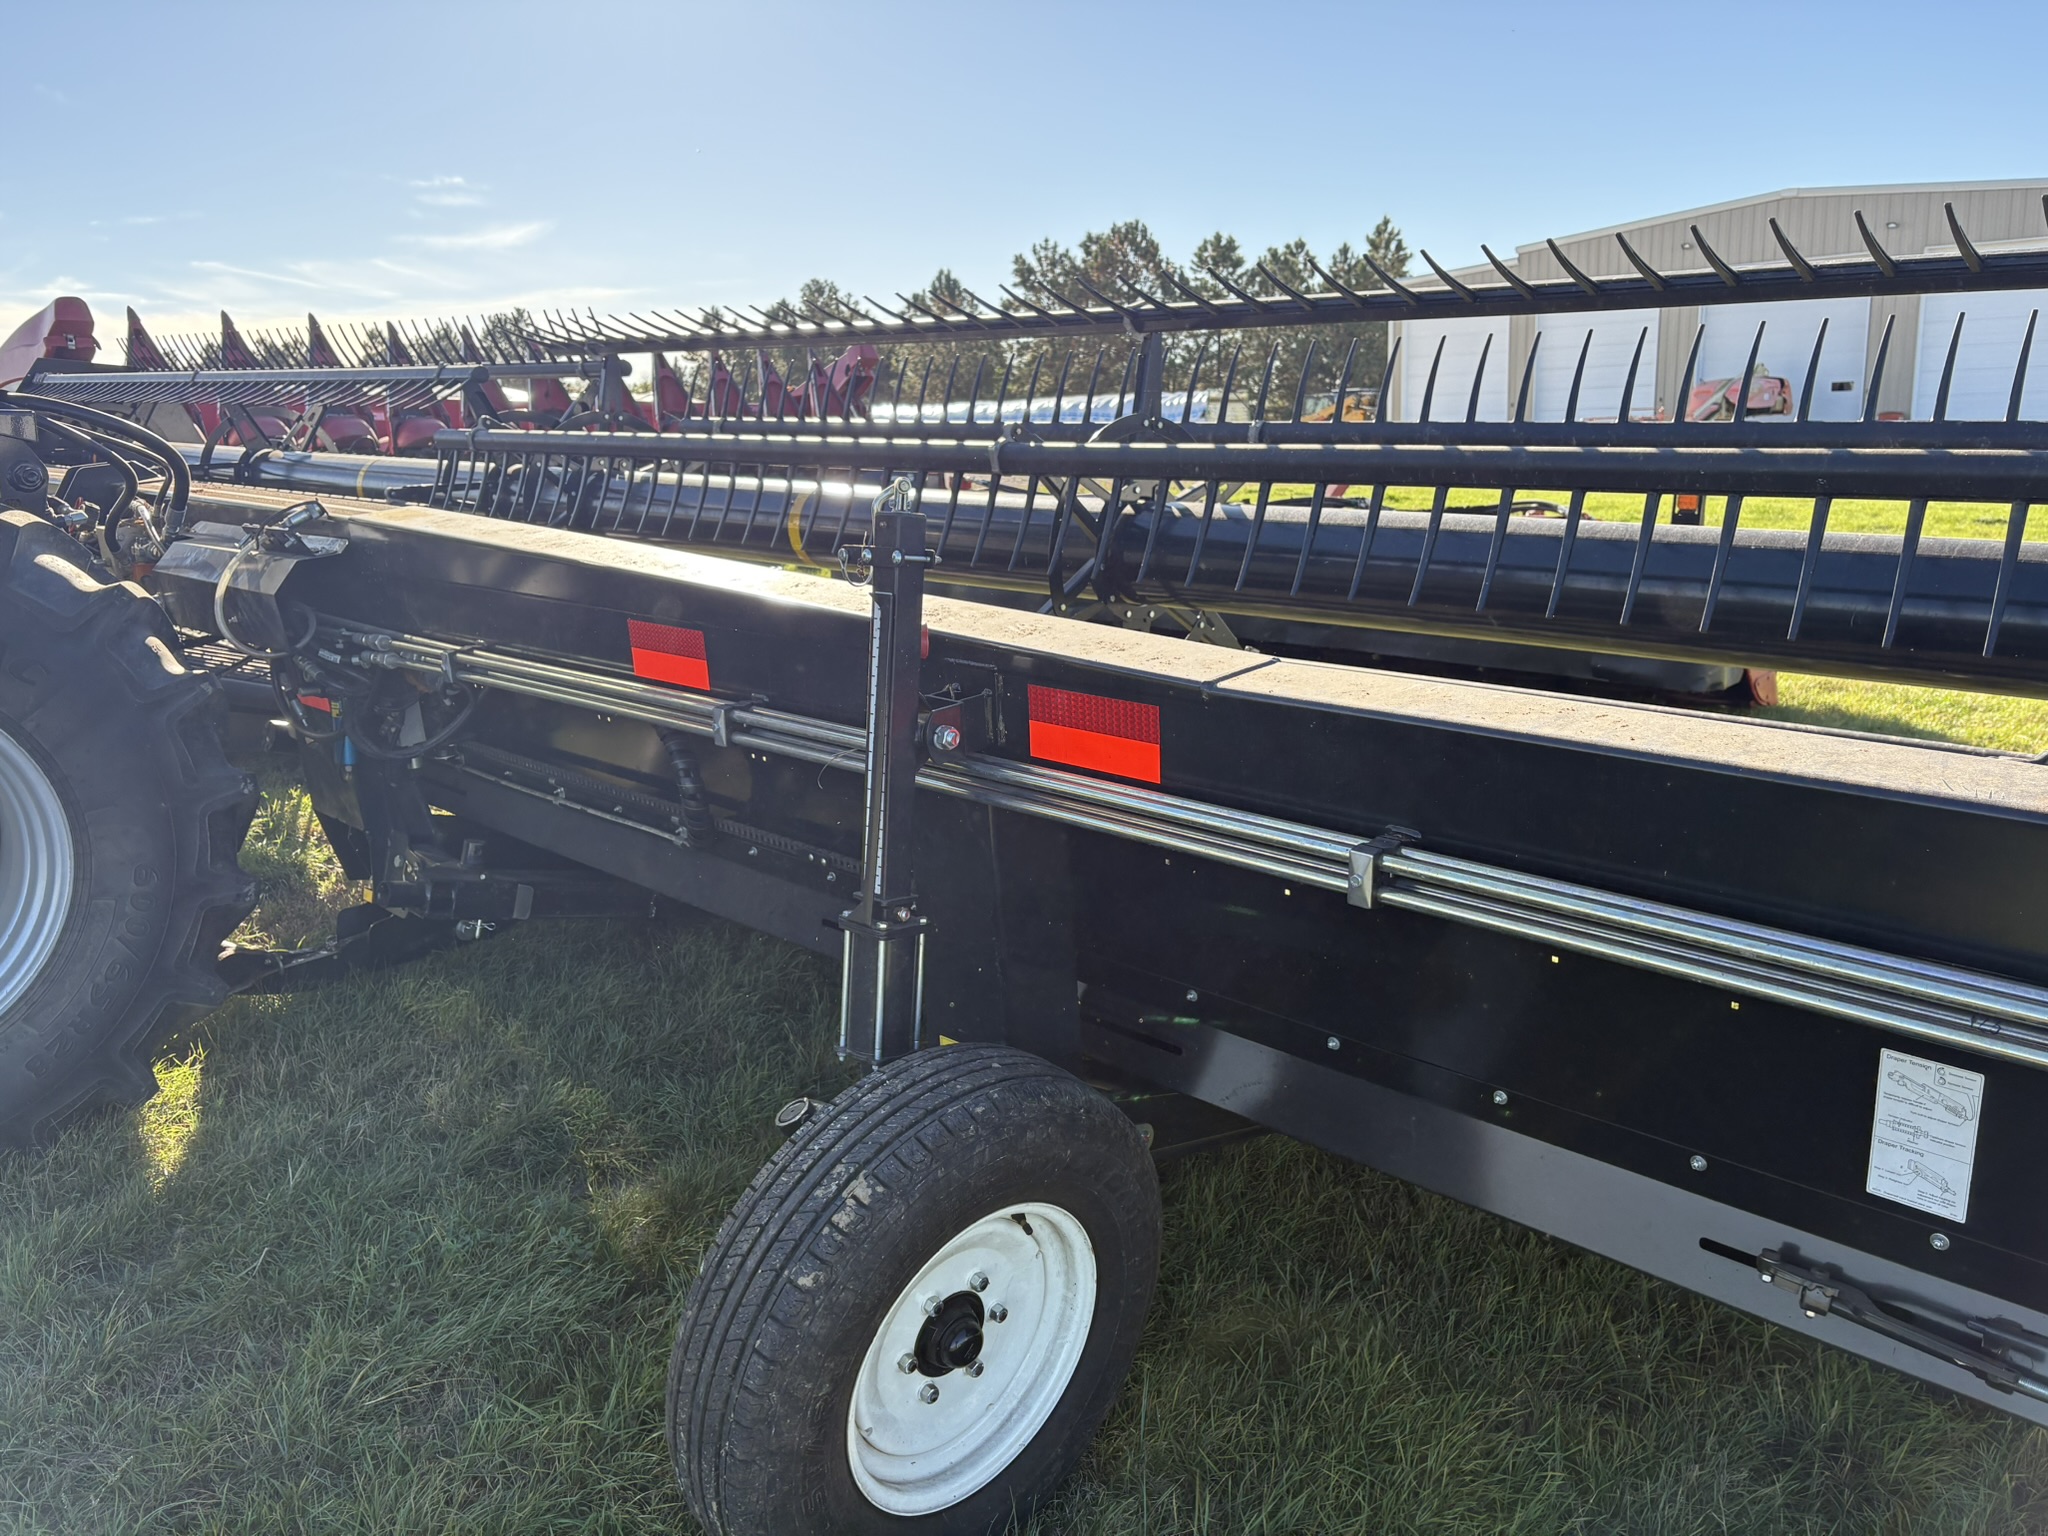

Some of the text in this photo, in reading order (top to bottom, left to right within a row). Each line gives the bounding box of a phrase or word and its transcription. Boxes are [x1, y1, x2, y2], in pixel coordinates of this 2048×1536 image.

[1886, 1053, 1933, 1071] Draper Tension
[1877, 1138, 1899, 1150] Draper
[1899, 1145, 1925, 1158] Tracking
